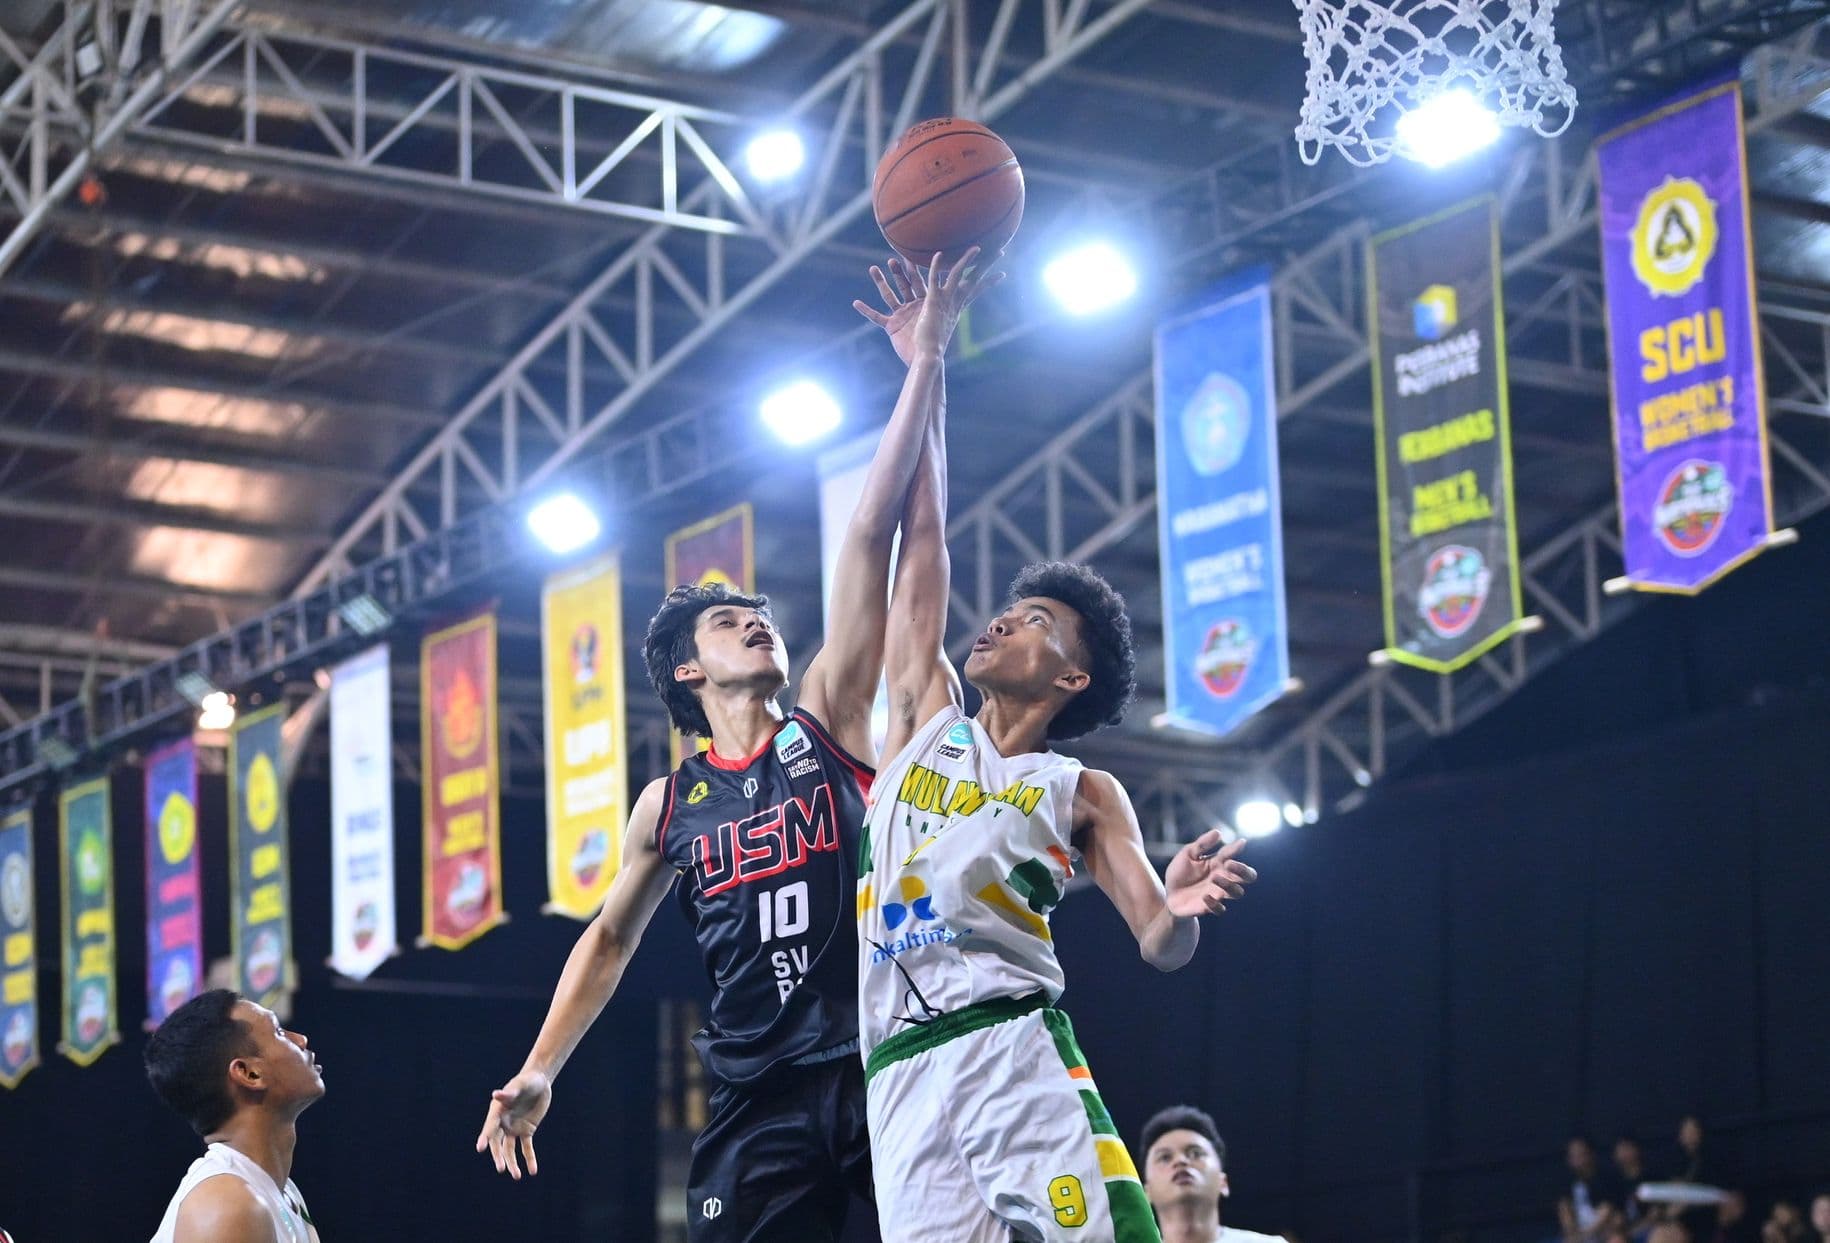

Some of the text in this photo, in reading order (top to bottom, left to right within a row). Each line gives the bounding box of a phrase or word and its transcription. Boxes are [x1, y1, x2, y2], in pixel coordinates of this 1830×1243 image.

[1640, 307, 1726, 383] SCU
[780, 737, 804, 756] CAMPUS
[783, 744, 805, 760] LEAGUE
[936, 748, 961, 760] LEAGUE
[940, 743, 966, 755] CAMPUS
[790, 763, 820, 779] RACISM
[797, 758, 809, 769] NO
[692, 783, 839, 897] USM
[758, 880, 809, 943] 10
[771, 945, 808, 979] SV
[1047, 1174, 1088, 1230] 9
